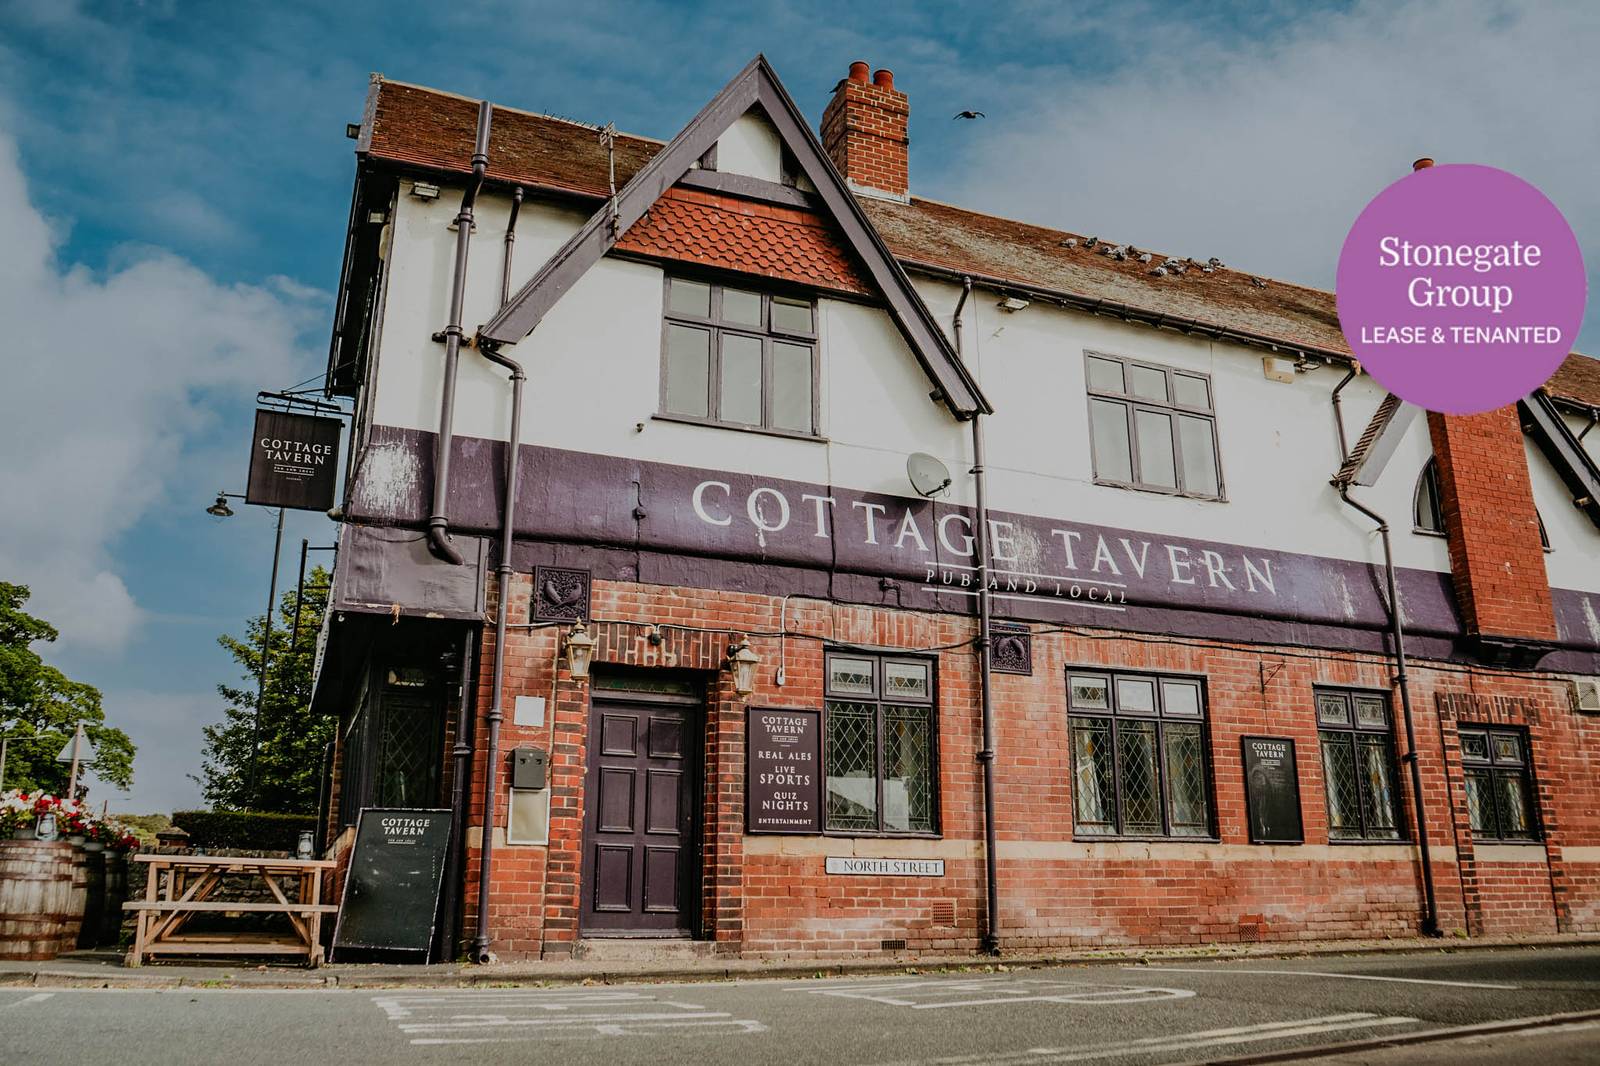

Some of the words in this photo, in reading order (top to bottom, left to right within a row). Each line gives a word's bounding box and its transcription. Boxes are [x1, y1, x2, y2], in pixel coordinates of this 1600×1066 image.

[261, 438, 332, 455] COTTAGE
[264, 449, 324, 465] TAVERN
[692, 480, 1018, 561] COTTAGE
[1051, 528, 1277, 596] TAVERN
[926, 569, 971, 587] PUB
[988, 577, 1037, 593] AND
[1056, 583, 1128, 605] LOCAL
[761, 716, 808, 726] COTTAGE
[765, 725, 804, 734] TAVERN
[1252, 743, 1286, 751] COTTAGE
[758, 751, 783, 760] REAL
[788, 752, 812, 761] ALES
[1255, 750, 1284, 758] TAVERN
[775, 766, 796, 774] LIVE
[760, 773, 810, 786] SPORTS
[773, 791, 797, 800] QUIZ
[762, 800, 809, 811] NIGHTS
[381, 818, 431, 827] COTTAGE
[384, 827, 425, 835] TAVERN
[843, 860, 888, 872] NORTH
[893, 862, 940, 874] STREET
